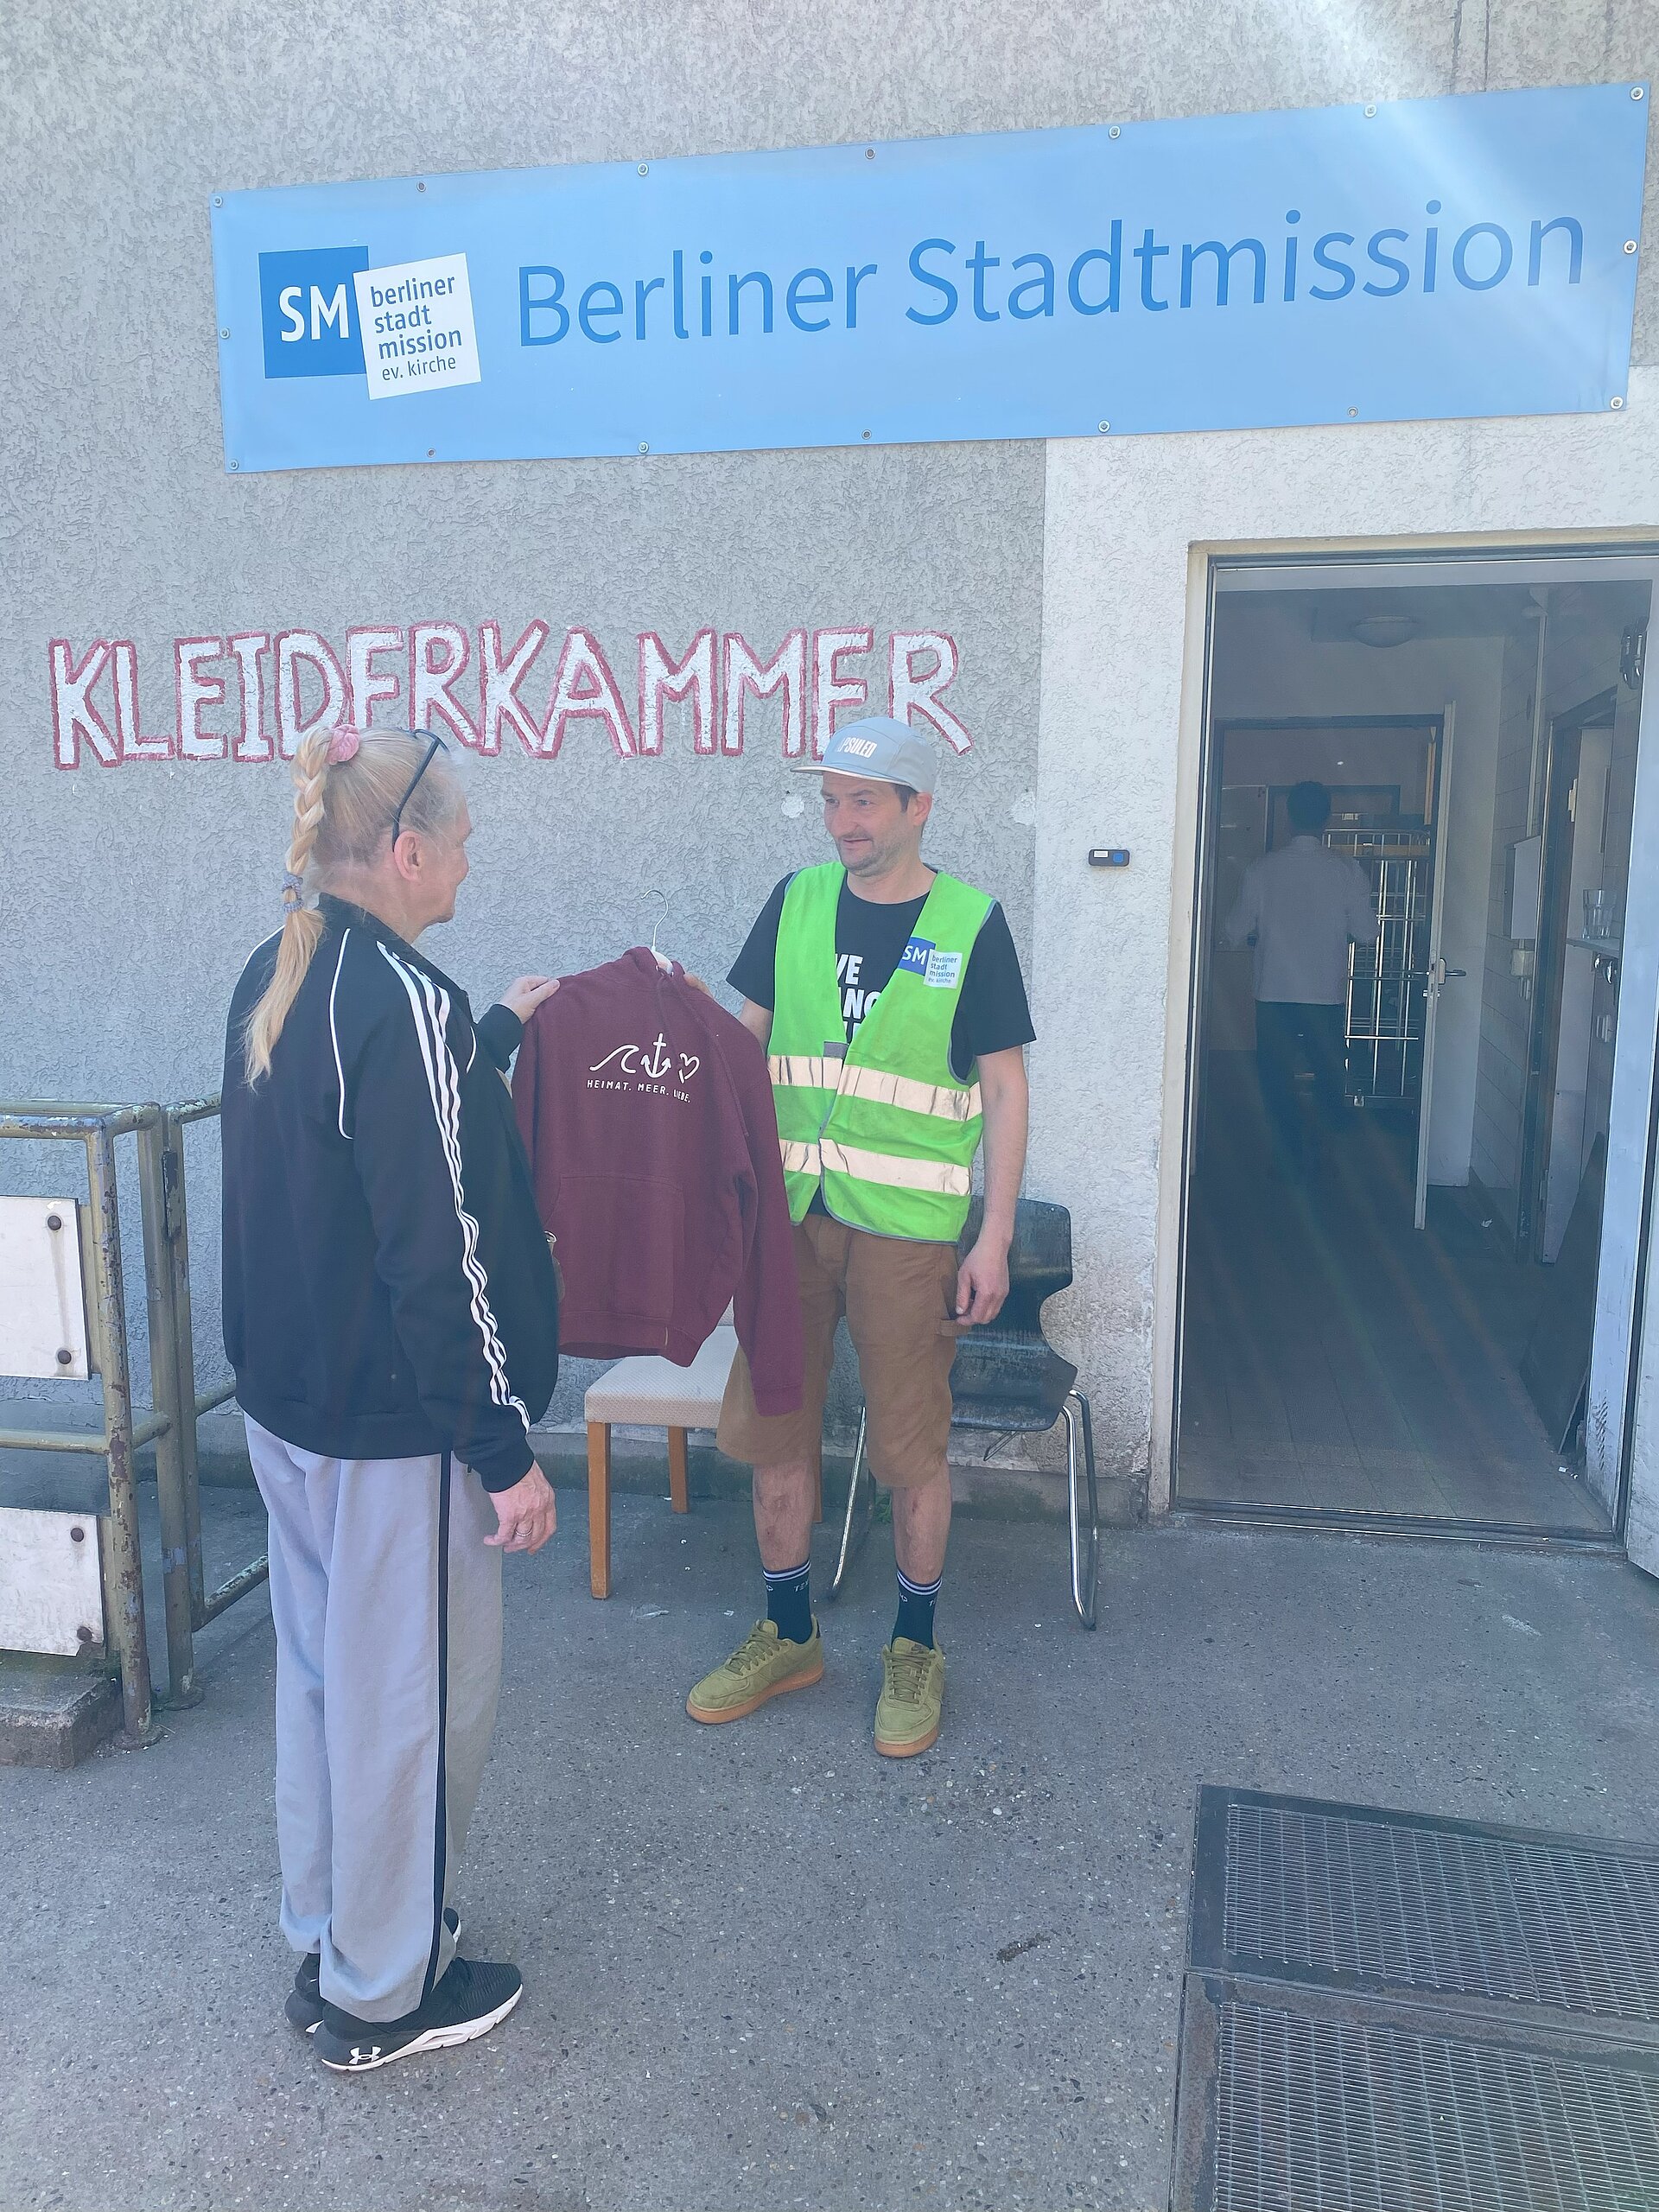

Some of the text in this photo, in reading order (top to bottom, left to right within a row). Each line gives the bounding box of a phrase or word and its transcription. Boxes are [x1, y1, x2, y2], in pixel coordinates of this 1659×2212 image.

[518, 199, 1584, 346] Berliner Stadtmission
[370, 275, 456, 308] berliner
[278, 283, 350, 343] SM
[373, 304, 433, 334] stadt
[378, 327, 463, 359] mission
[381, 354, 457, 381] ev. kirche
[901, 945, 928, 965] SM
[931, 954, 958, 964] berliner
[931, 963, 948, 971] stadt
[929, 969, 956, 978] mission
[587, 1079, 691, 1103] HEIMAT. MEER. LIEBE.
